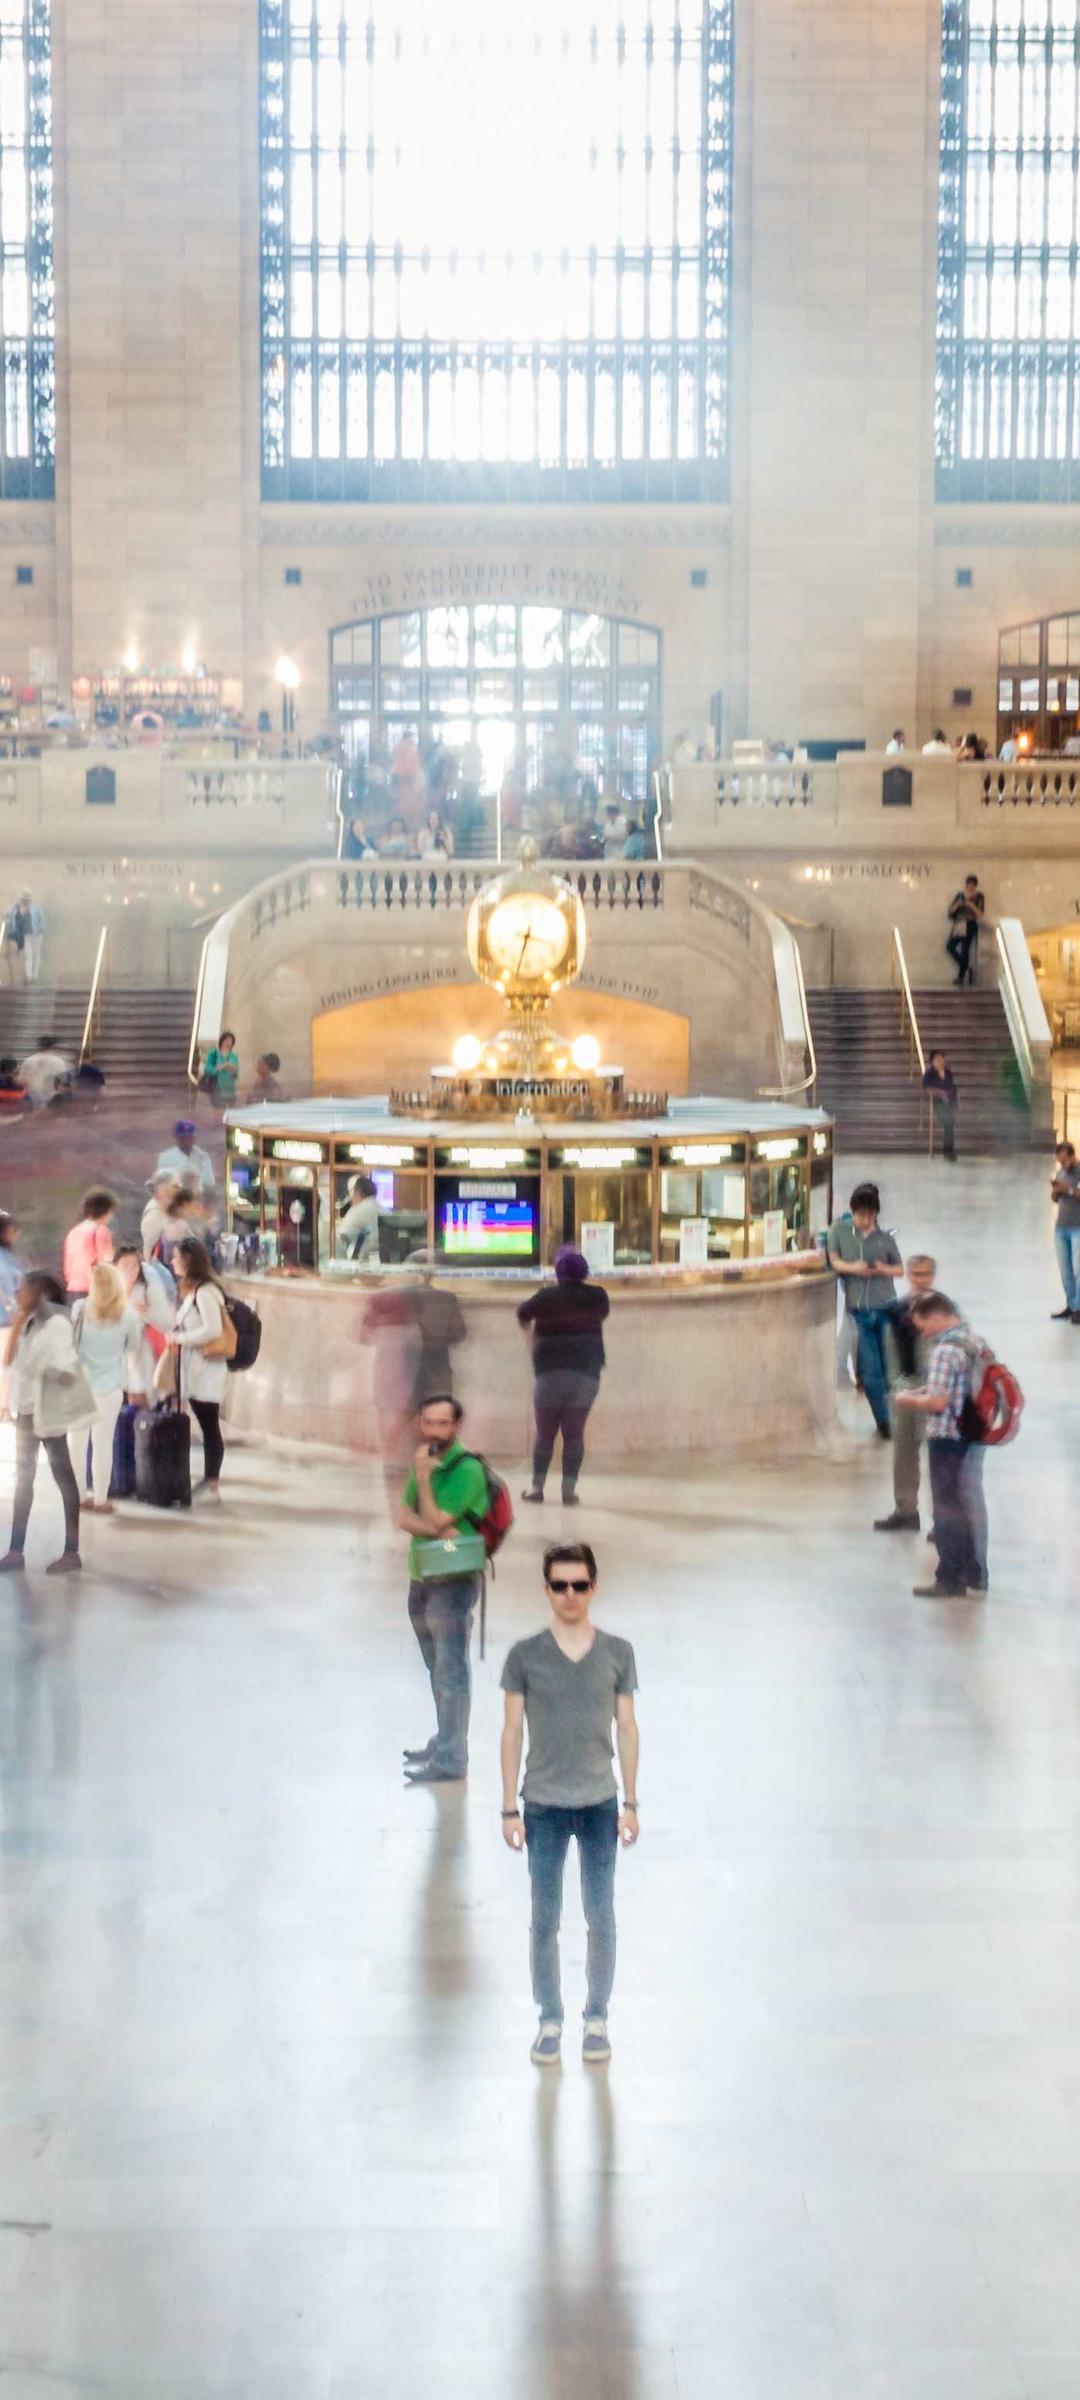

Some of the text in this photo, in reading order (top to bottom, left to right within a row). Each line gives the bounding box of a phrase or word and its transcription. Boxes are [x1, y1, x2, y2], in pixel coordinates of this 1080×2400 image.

[366, 574, 391, 592] TO
[403, 562, 534, 586] VANDERBILT
[349, 591, 391, 614] THE
[66, 863, 109, 875] WEST
[861, 864, 933, 877] BALCONY
[320, 968, 457, 1008] DINING CONCOURSE
[496, 1078, 588, 1097] Information
